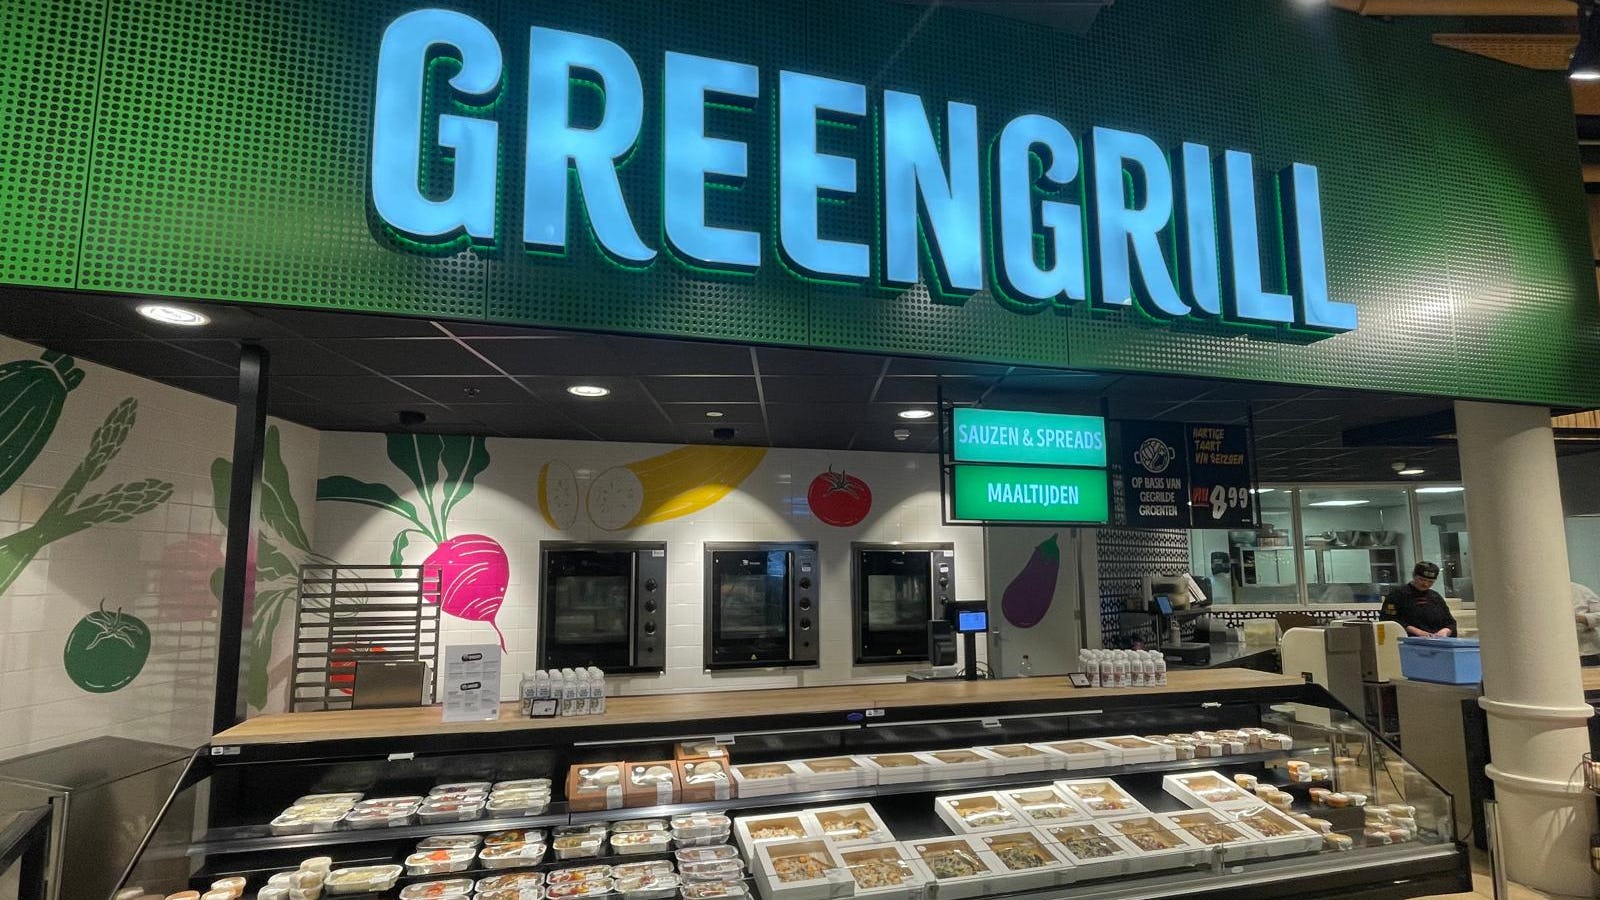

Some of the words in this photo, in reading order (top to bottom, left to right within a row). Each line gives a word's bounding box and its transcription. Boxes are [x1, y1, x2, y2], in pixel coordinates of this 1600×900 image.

[372, 8, 1357, 331] GREENGRILL
[958, 424, 1019, 446] SAUZEN
[1022, 428, 1034, 447] &
[1036, 428, 1103, 450] SPREADS
[1131, 477, 1143, 488] OP
[1144, 478, 1164, 489] BASIS
[1166, 478, 1181, 490] VAN
[987, 482, 1079, 507] MAALTIJDEN
[1140, 492, 1175, 502] GEGRILDE
[1139, 505, 1177, 516] GROENTEN
